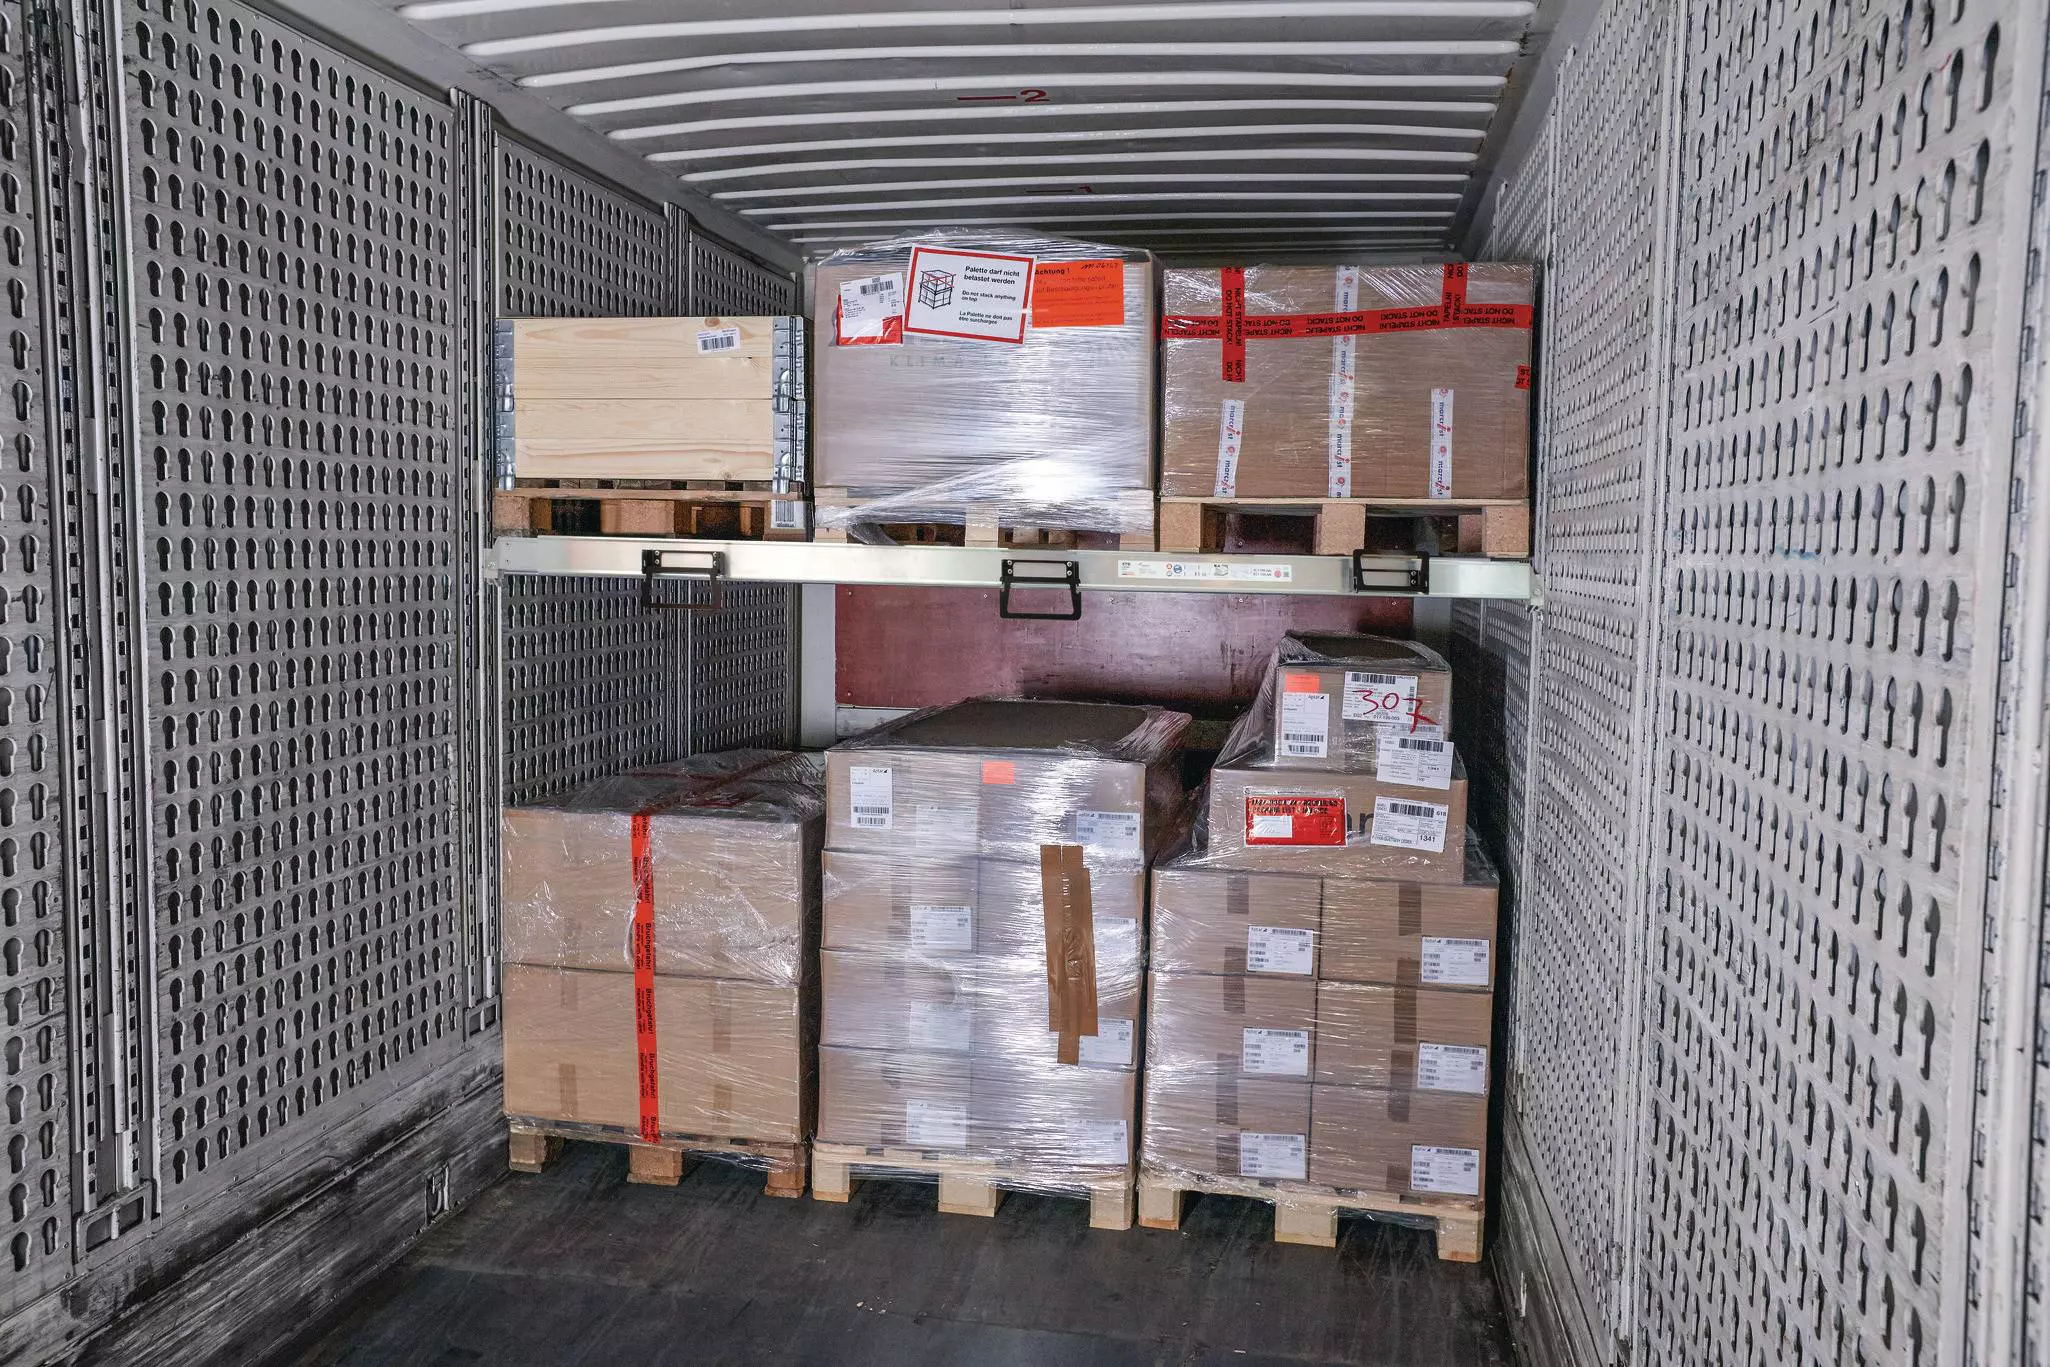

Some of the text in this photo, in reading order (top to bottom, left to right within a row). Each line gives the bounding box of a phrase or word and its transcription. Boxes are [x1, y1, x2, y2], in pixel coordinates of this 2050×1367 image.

[1020, 89, 1050, 103] 2
[965, 265, 1020, 277] Palette darf nicht
[963, 274, 1015, 285] belastet werden
[994, 293, 1016, 301] anything
[1443, 291, 1452, 322] TAPELN!
[1464, 307, 1514, 315] DO NOT STAC
[1335, 315, 1351, 324] NOT
[1380, 309, 1438, 321] DO NOT STACK!
[1379, 319, 1440, 330] NICHT STAPELN!
[1462, 317, 1516, 325] NICHT STAPEL
[1245, 328, 1293, 336] NICHT STAPE
[1343, 324, 1366, 332] NICHT
[1351, 689, 1440, 734] 307
[1419, 834, 1436, 843] 1341
[645, 988, 653, 1035] Bruchgefahr!
[648, 1053, 656, 1099] Bruchgefahr!
